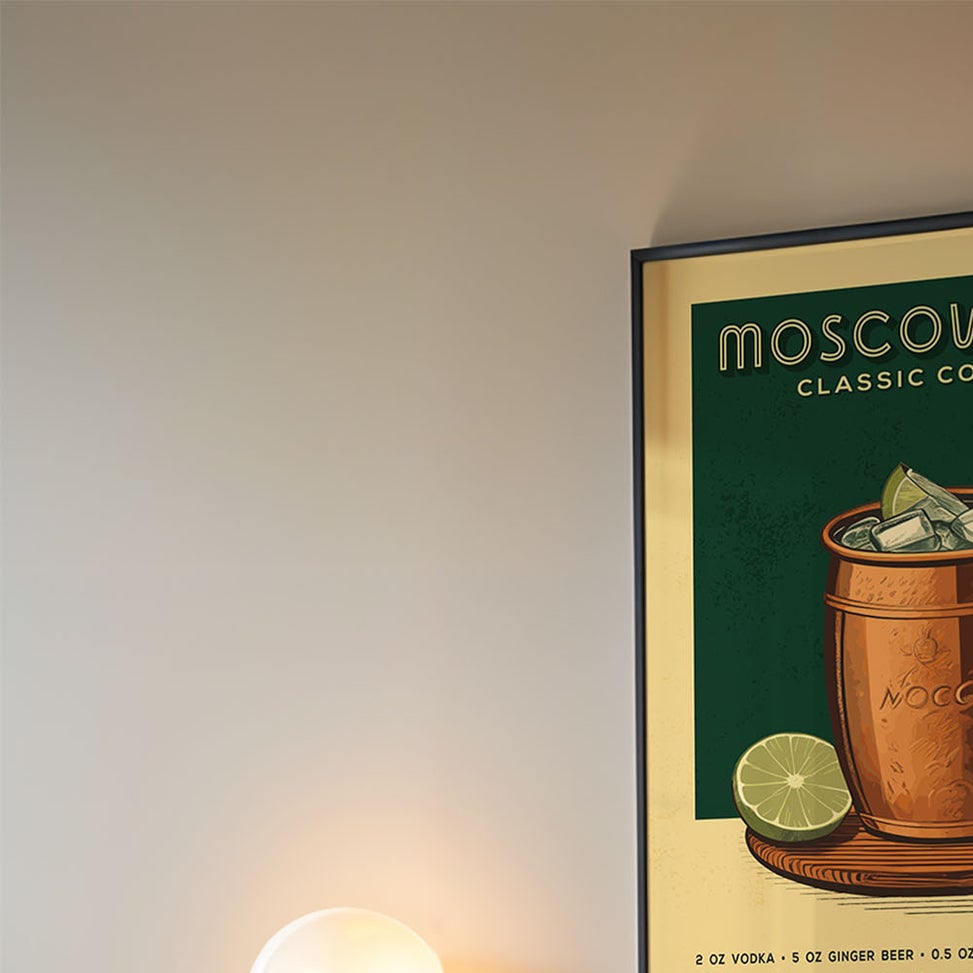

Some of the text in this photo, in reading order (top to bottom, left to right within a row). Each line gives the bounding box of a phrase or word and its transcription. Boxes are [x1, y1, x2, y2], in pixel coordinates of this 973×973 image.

[797, 369, 925, 397] CLASSIC
[696, 954, 703, 965] 2
[709, 954, 725, 965] OZ
[732, 953, 775, 964] VODKA
[792, 952, 799, 963] 5
[805, 951, 822, 963] OZ
[828, 950, 875, 962] GINGER
[881, 949, 914, 960] BEER
[931, 948, 952, 960] 0.5
